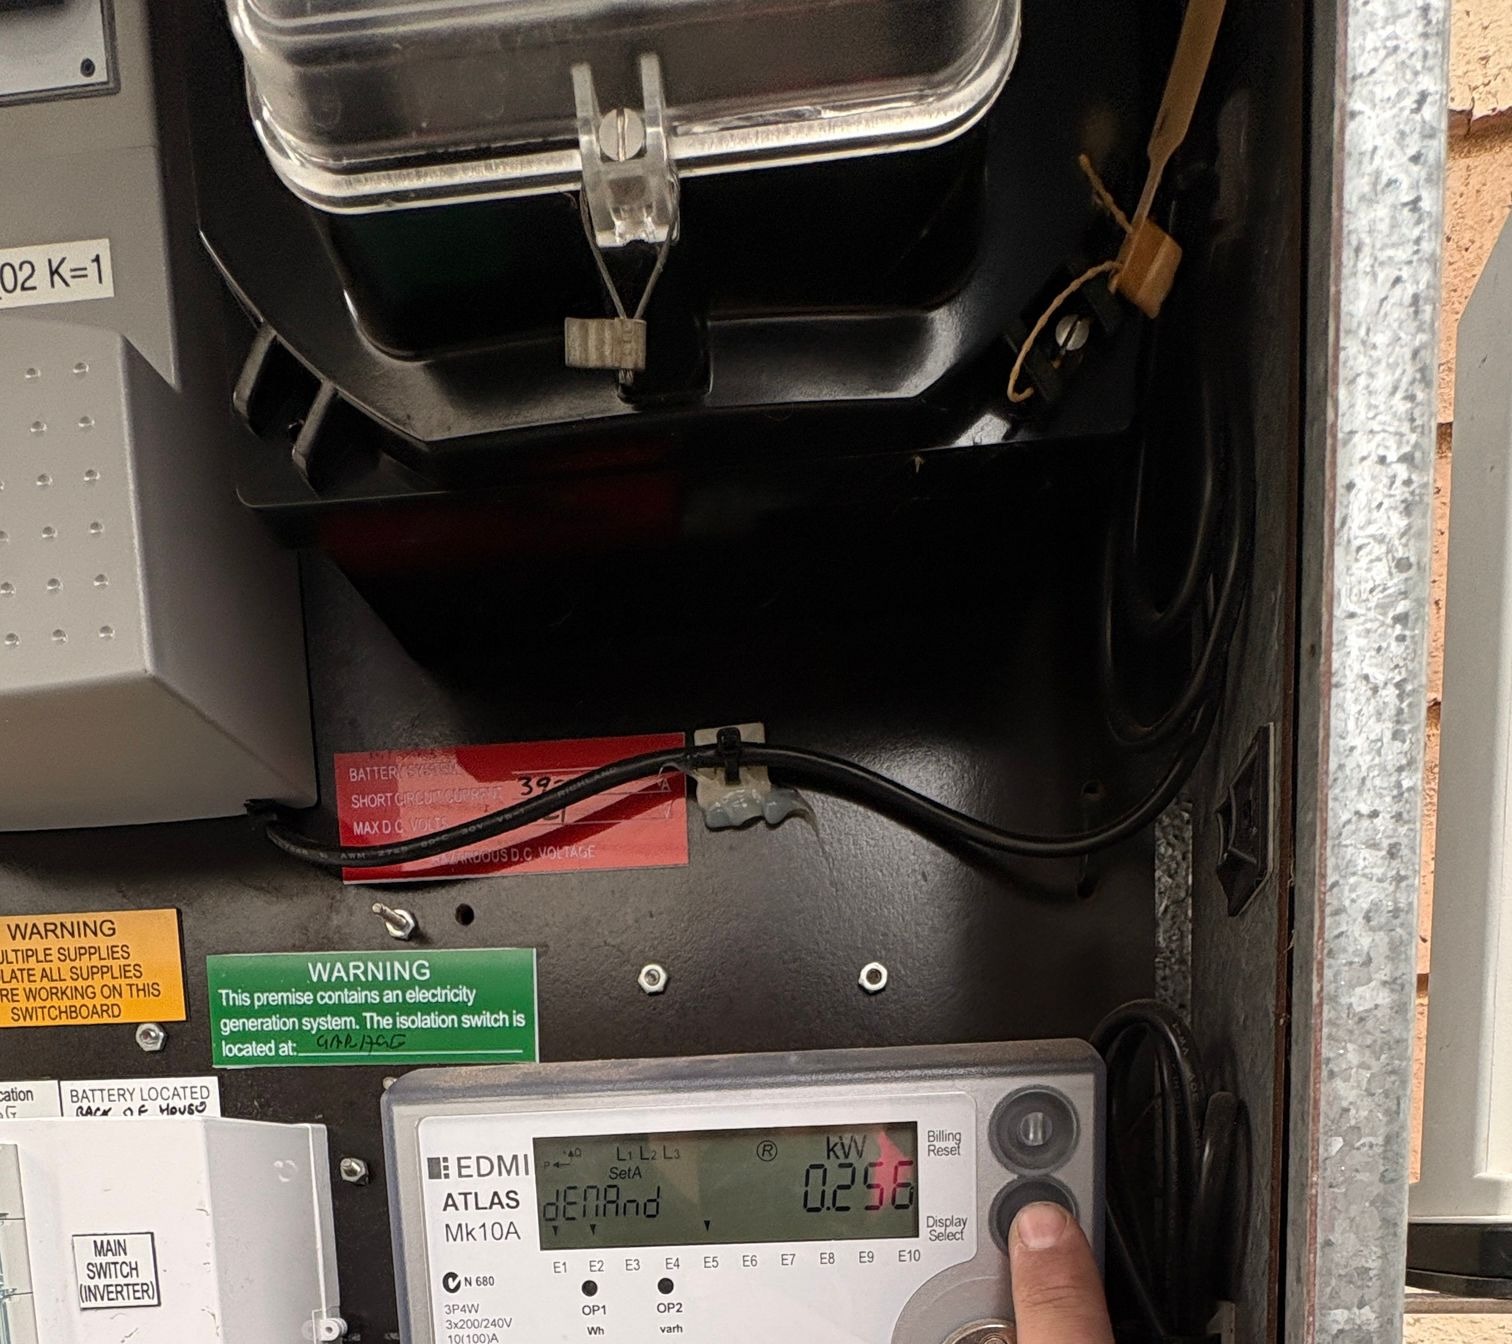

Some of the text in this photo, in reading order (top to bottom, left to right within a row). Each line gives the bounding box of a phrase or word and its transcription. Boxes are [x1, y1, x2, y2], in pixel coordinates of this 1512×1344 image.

[48, 253, 103, 289] K=1
[351, 793, 393, 808] SHORT
[353, 821, 380, 836] MAX
[538, 845, 597, 860] VOLTAGE
[7, 919, 117, 941] WARNING
[57, 944, 131, 963] SUPPLIES
[40, 966, 66, 983] ALL
[70, 963, 143, 981] SUPPLIES
[308, 959, 431, 983] WARNING
[23, 984, 97, 1002] WORKING
[100, 983, 123, 1000] ON
[126, 982, 161, 998] THIS
[218, 985, 477, 1011] This premise contains an electricity
[11, 1003, 122, 1023] SWITCHBOARD
[220, 1010, 526, 1036] generation system. The isolation switch is
[222, 1039, 298, 1058] located at:
[70, 1085, 210, 1104] BATTERY LOCATED
[826, 1133, 868, 1161] kW
[927, 1130, 962, 1147] Billing
[928, 1144, 961, 1157] Reset
[457, 1153, 530, 1179] EDMI
[803, 1160, 914, 1213] 0.256
[442, 1189, 521, 1212] ATLAS
[445, 1221, 521, 1243] Mk10A
[926, 1216, 968, 1233] Display
[928, 1228, 965, 1242] Select
[93, 1239, 128, 1257] MAIN
[86, 1261, 139, 1280] SWITCH
[553, 1249, 921, 1274] E1 E2 E3 E4 E5 E6 E7 E8 E9 E10
[464, 1275, 495, 1288] N 680
[79, 1281, 156, 1304] (INVERTER)
[444, 1303, 480, 1316] 3P4W
[582, 1304, 607, 1316] OP1
[657, 1302, 683, 1314] OP2
[446, 1317, 513, 1330] 3x200/240V
[587, 1325, 605, 1336] Wh
[659, 1323, 683, 1334] varh
